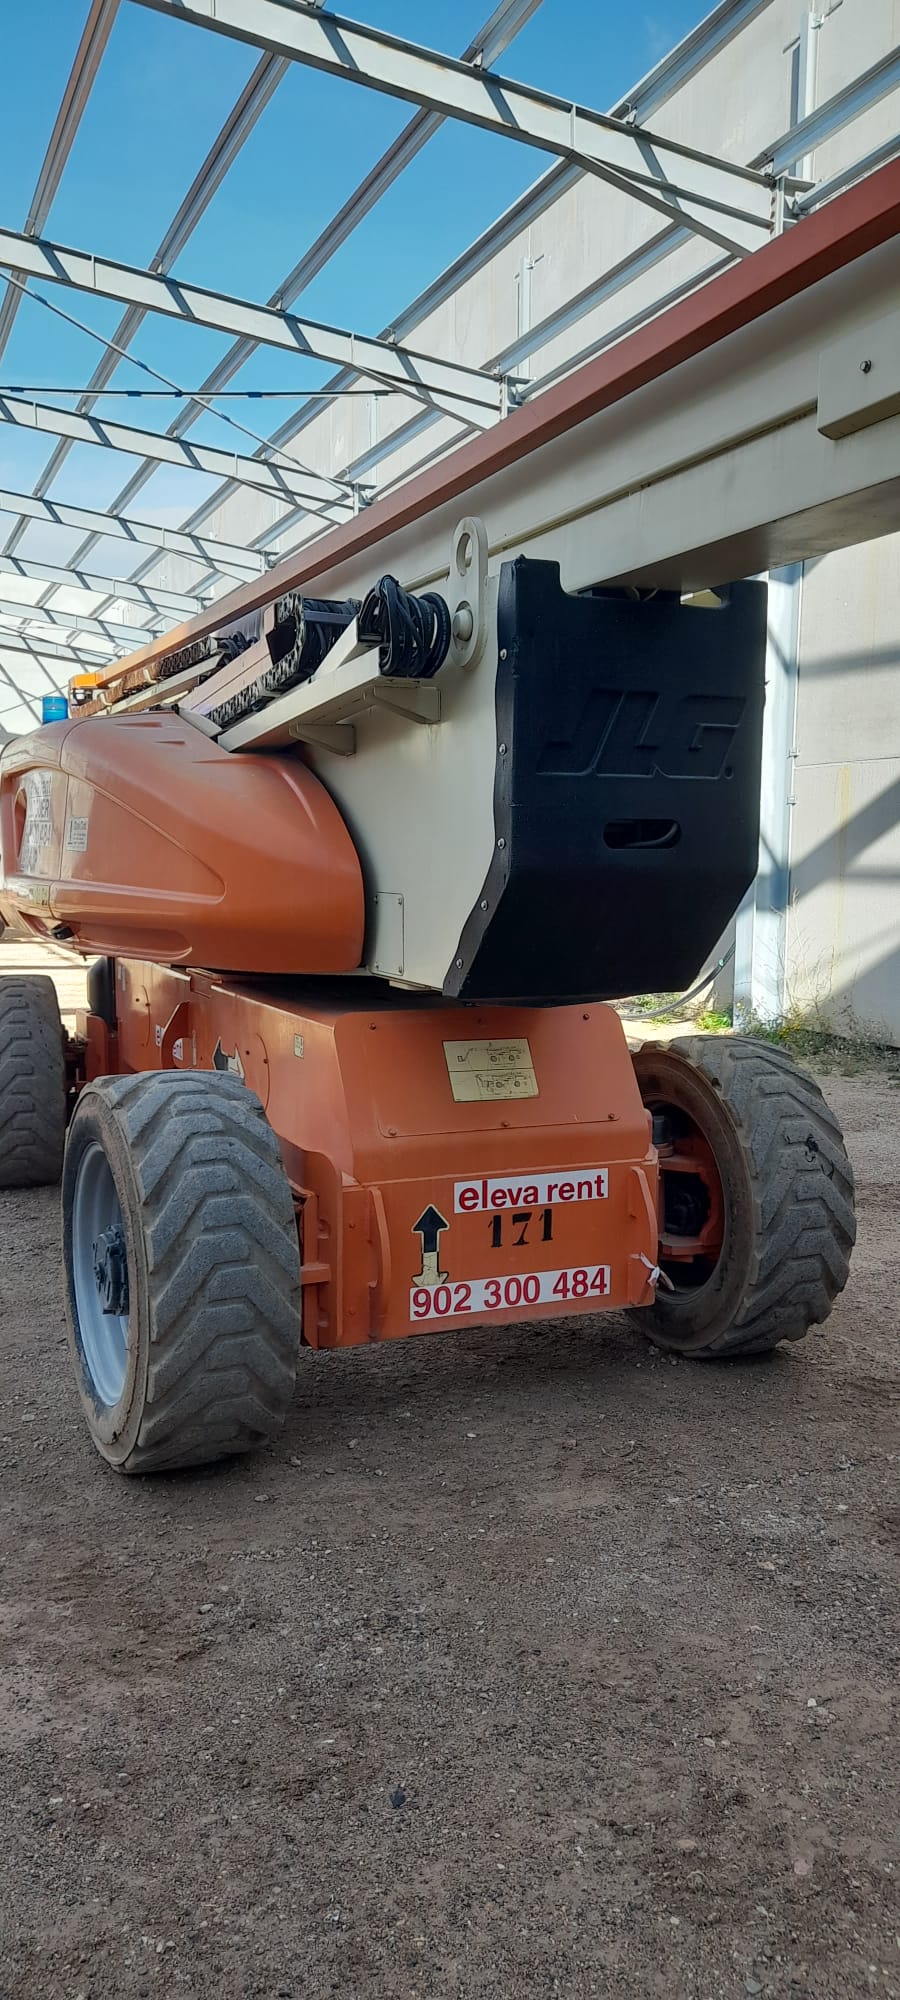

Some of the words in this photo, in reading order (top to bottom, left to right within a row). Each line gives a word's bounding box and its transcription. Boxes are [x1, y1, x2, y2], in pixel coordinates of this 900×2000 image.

[547, 1175, 605, 1201] rent
[488, 1209, 553, 1248] 171
[413, 1284, 471, 1317] 902
[484, 1275, 541, 1309] 300
[553, 1267, 607, 1299] 484
